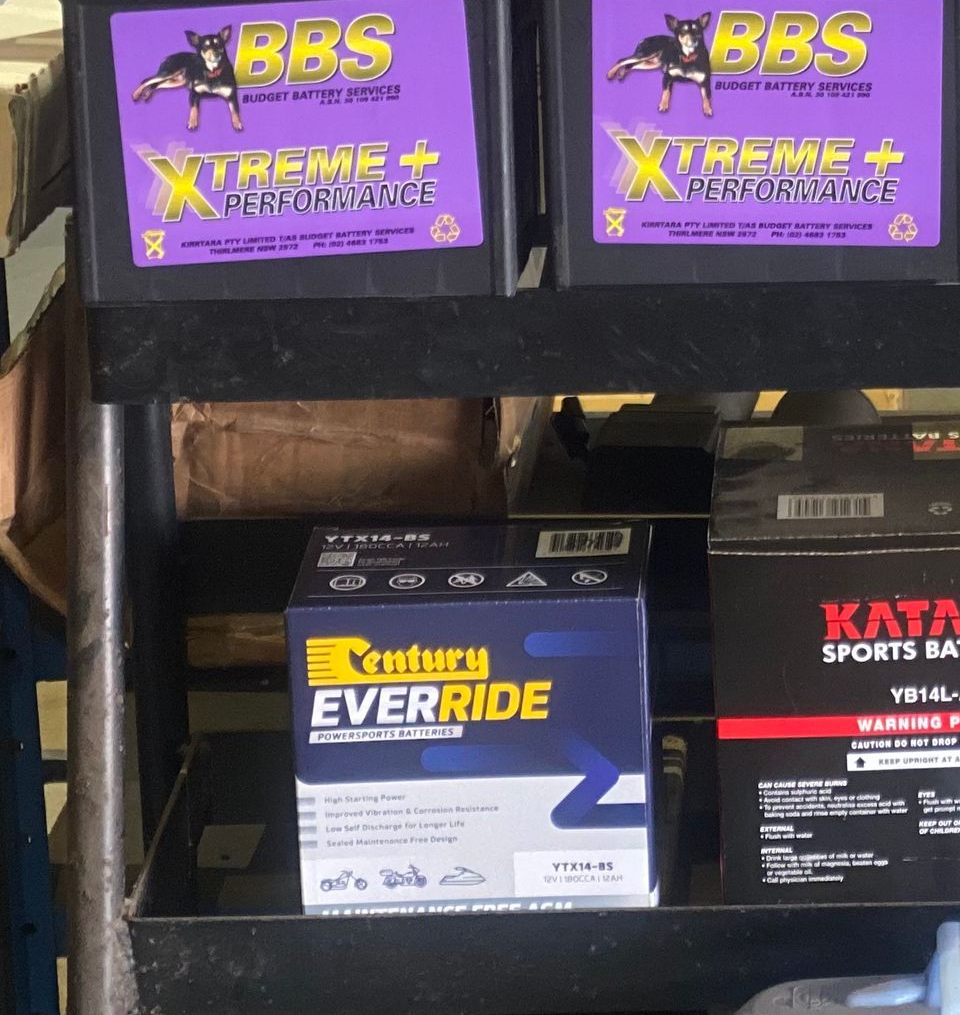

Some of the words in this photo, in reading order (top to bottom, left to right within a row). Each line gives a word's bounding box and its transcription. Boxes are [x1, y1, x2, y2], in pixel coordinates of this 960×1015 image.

[234, 13, 397, 89] BBS
[709, 11, 873, 78] BBS
[242, 91, 289, 104] BUDGET
[292, 88, 343, 100] BATTERY
[346, 84, 401, 97] SERVICES
[714, 81, 762, 91] BUDGET
[764, 82, 816, 92] BATTERY
[818, 82, 873, 92] SERVICES
[613, 136, 856, 203] XTREME
[147, 142, 390, 224] XTREME
[686, 177, 899, 206] PERFORMANCE
[222, 180, 438, 220] PERFORMANCE
[324, 533, 432, 543] YTX14-BS
[822, 639, 918, 665] SPORTS
[306, 637, 489, 686] Century
[310, 680, 552, 728] EVERRIDE
[856, 715, 943, 733] WARNING
[317, 729, 396, 741] POWERSPORTS
[398, 728, 455, 739] BATTERIES
[851, 739, 892, 750] CAUTION
[894, 739, 908, 748] DO
[910, 738, 929, 748] NOT
[932, 737, 958, 747] DROP
[878, 757, 900, 766] KEEP
[903, 756, 939, 765] UPRIGHT
[941, 755, 953, 763] AT
[324, 796, 343, 805] High
[344, 795, 378, 804] Starting
[380, 793, 406, 802] Power
[325, 810, 363, 819] Improved
[365, 808, 404, 817] Vibration
[413, 806, 454, 815] Corrosion
[455, 805, 499, 813] Resistance
[326, 825, 342, 833] Low
[344, 824, 360, 832] Self
[362, 822, 403, 833] Discharge
[404, 822, 417, 830] for
[418, 821, 447, 830] Longer
[449, 820, 465, 828] Life
[918, 827, 929, 835] OF
[326, 839, 354, 847] Sealed
[356, 837, 408, 847] Maintenance
[410, 836, 428, 844] Free
[430, 835, 458, 845] Design
[552, 861, 614, 872] YTX14-BS
